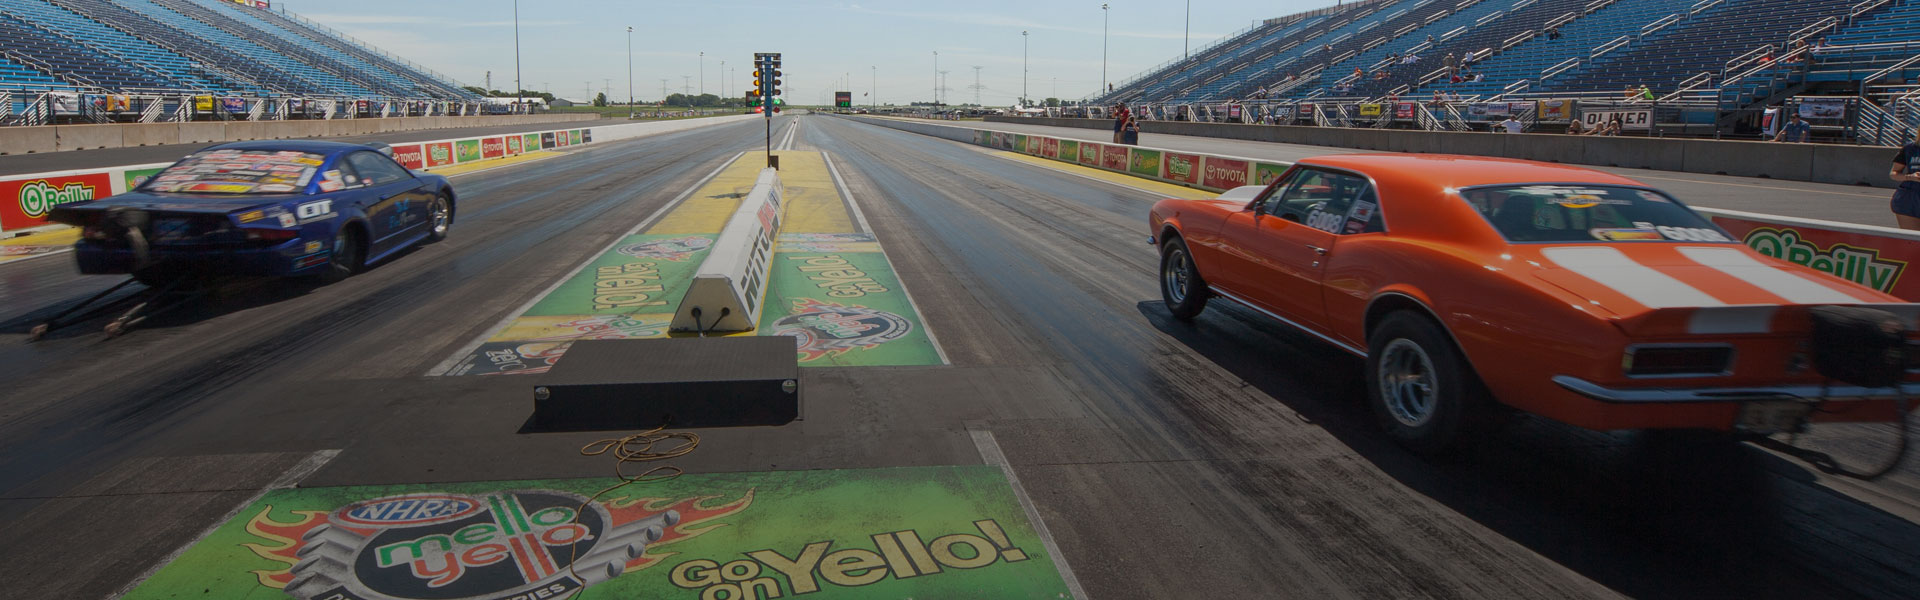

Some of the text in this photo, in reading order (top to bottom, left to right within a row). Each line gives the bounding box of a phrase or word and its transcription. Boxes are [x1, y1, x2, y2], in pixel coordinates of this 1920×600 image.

[399, 152, 422, 163] TOYOTA
[1215, 167, 1246, 183] TOYOTA
[21, 182, 94, 215] O'Reilly
[786, 255, 874, 289] Yello!
[1747, 232, 1899, 291] O'Reilly
[358, 500, 461, 521] NHRA
[378, 493, 575, 567] mello
[414, 525, 590, 586] yello
[743, 518, 1031, 596] Yello!
[668, 559, 762, 588] Go
[699, 577, 785, 600] on
